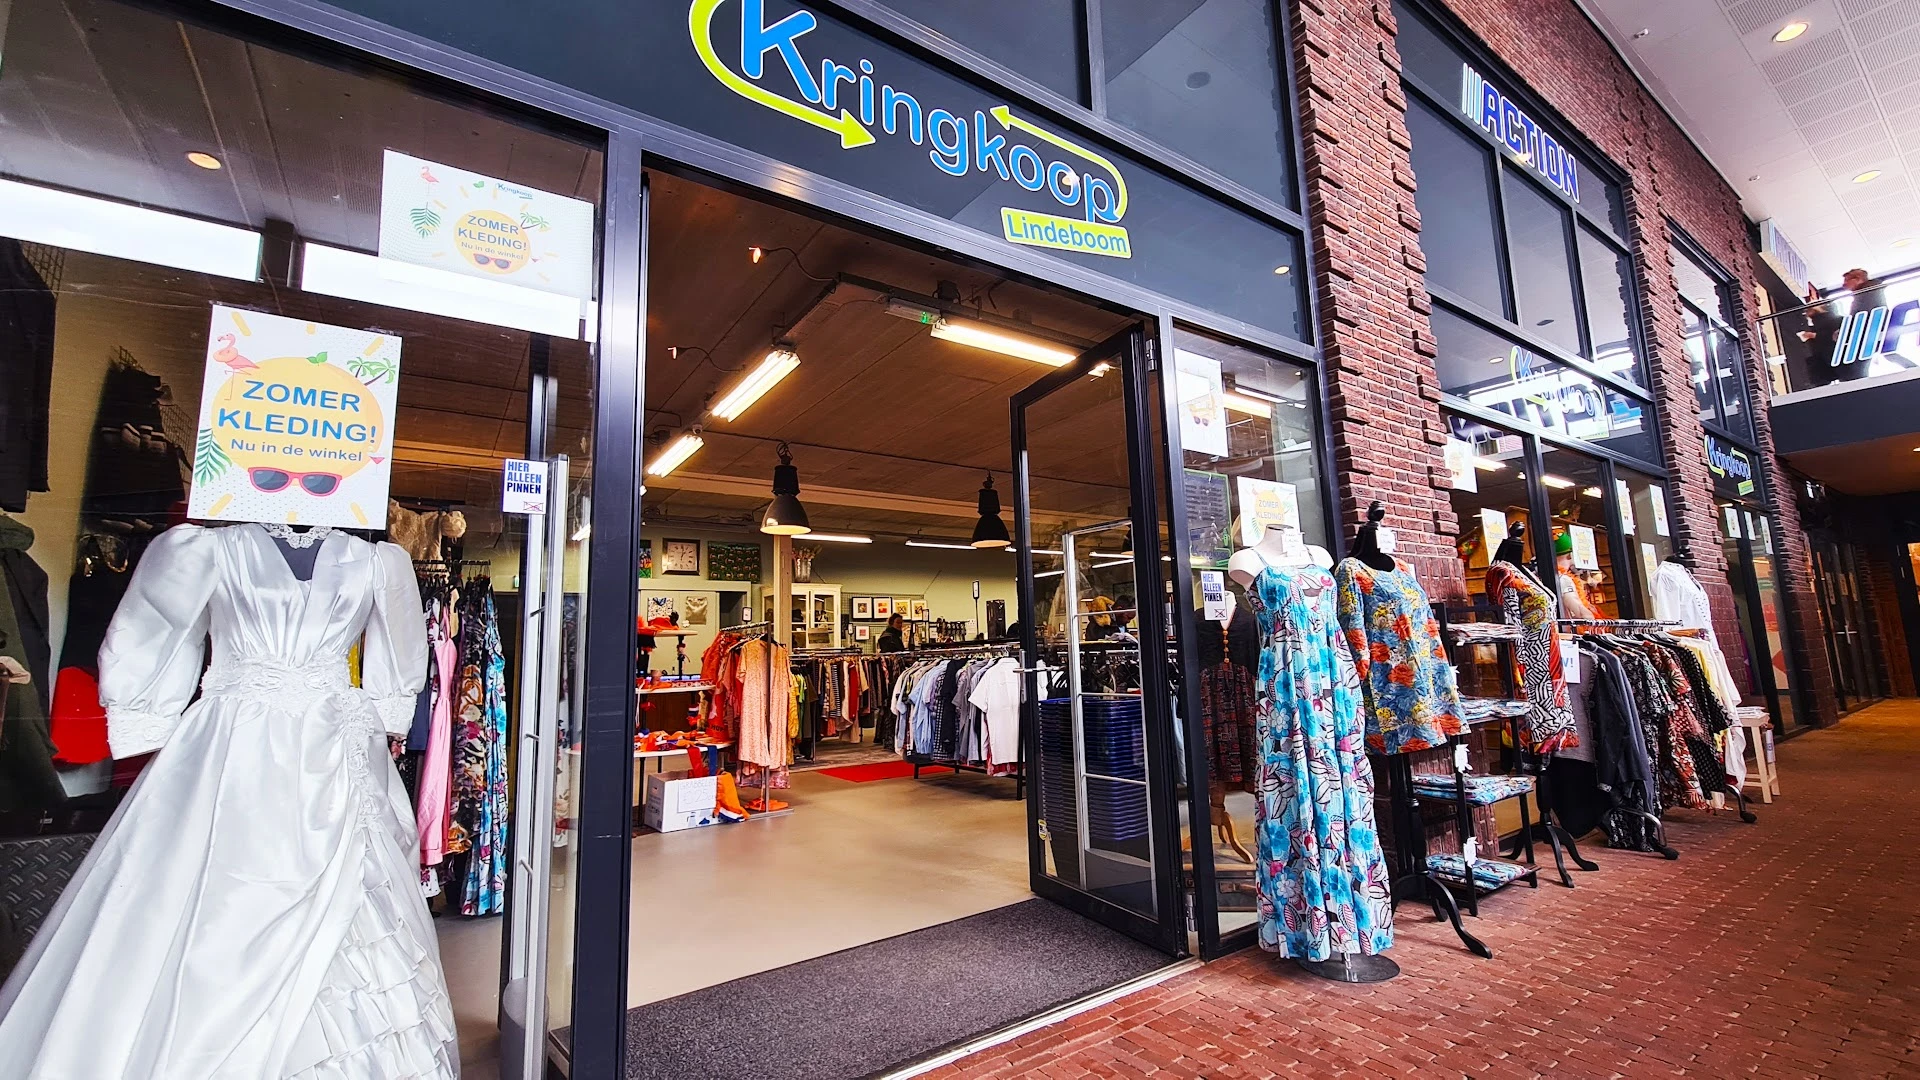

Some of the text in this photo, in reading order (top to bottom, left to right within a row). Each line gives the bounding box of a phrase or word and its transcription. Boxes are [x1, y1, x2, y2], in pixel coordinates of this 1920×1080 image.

[740, 0, 1117, 223] Kringkoop
[1480, 80, 1580, 204] ACTION
[467, 214, 519, 235] ZOMER
[1007, 213, 1128, 254] Lindeboom
[458, 227, 527, 251] KLEDING!
[461, 241, 473, 250] Nu
[475, 244, 483, 252] in
[497, 250, 524, 260] winkel
[242, 379, 361, 413] ZOMER
[218, 407, 377, 444] KLEDING!
[231, 438, 362, 462] Nu in de winkel
[507, 460, 530, 473] HIER
[507, 471, 542, 484] ALLEEN
[506, 482, 541, 495] PINNEN
[1202, 573, 1214, 583] HIER
[1203, 582, 1222, 593] ALLEEN
[1204, 592, 1223, 602] PINNEN
